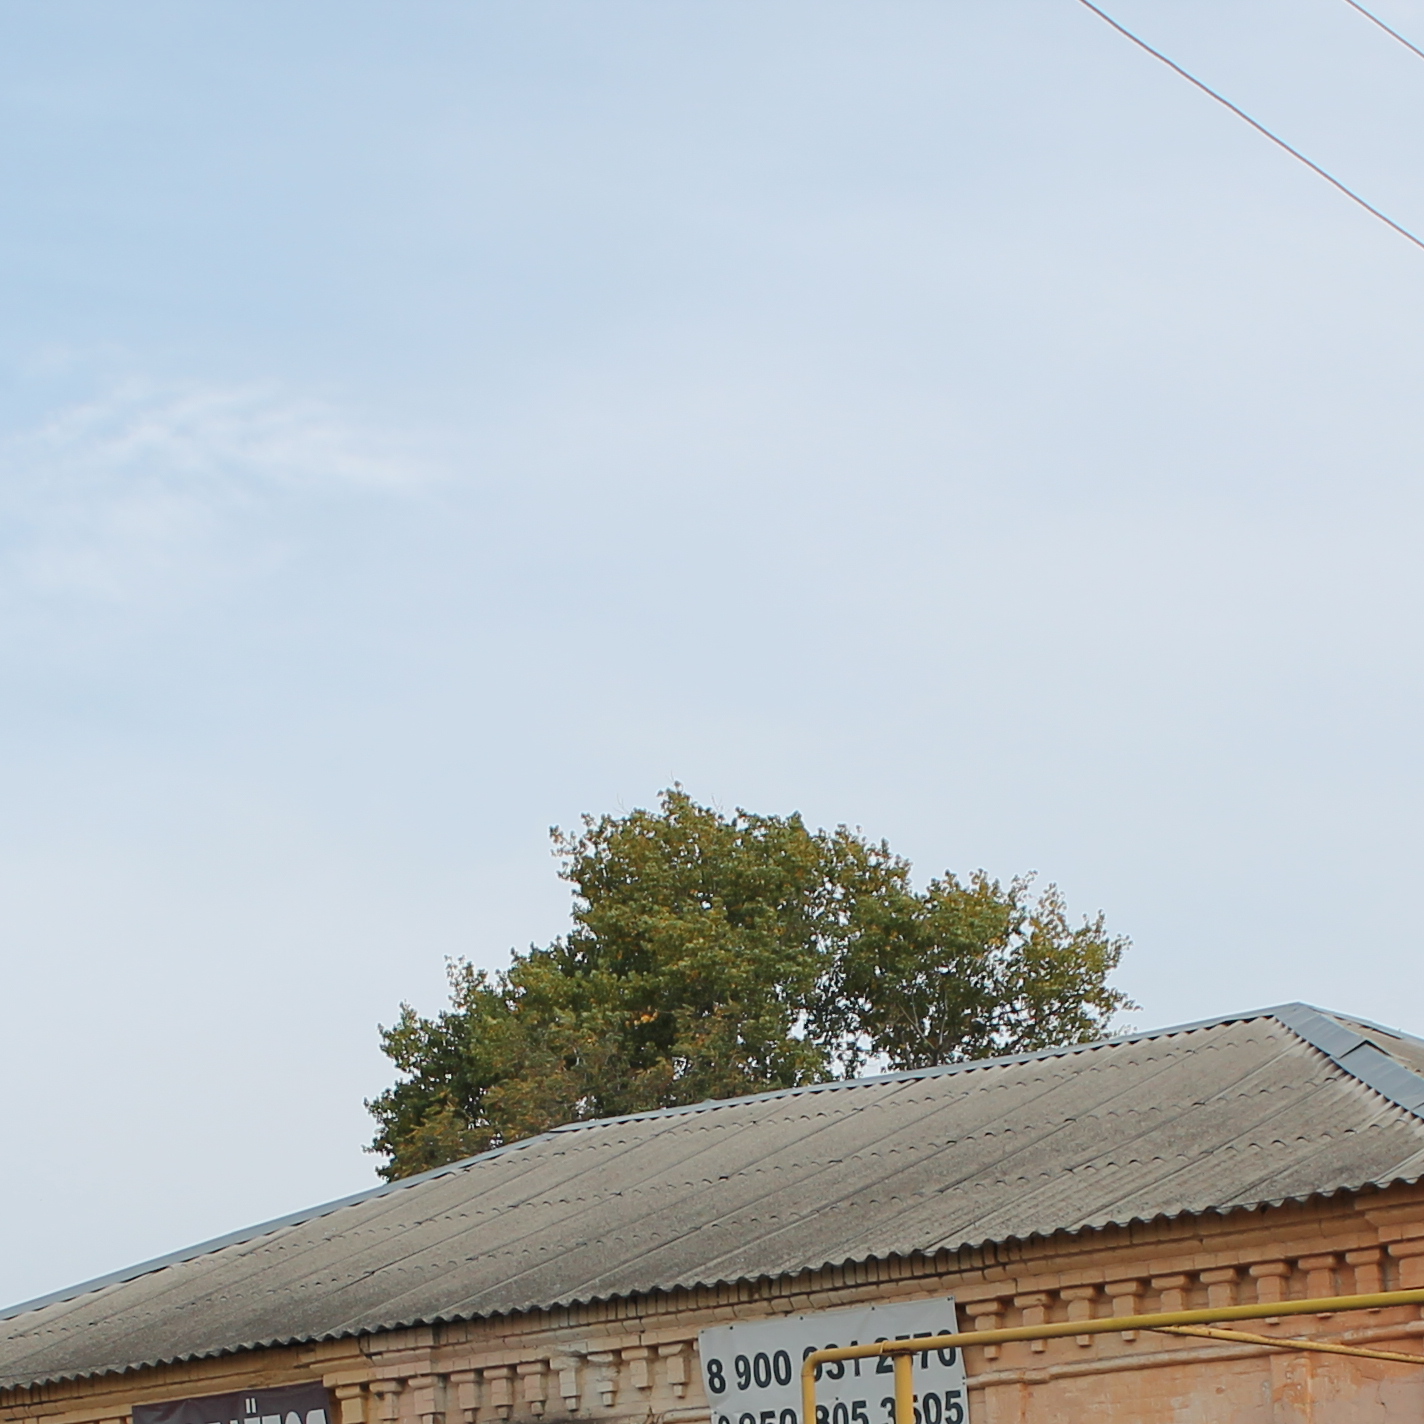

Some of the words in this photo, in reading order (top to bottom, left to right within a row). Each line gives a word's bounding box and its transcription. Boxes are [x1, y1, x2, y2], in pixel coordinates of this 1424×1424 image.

[707, 1358, 726, 1394] 8
[735, 1350, 792, 1390] 900
[874, 1329, 957, 1375] 270
